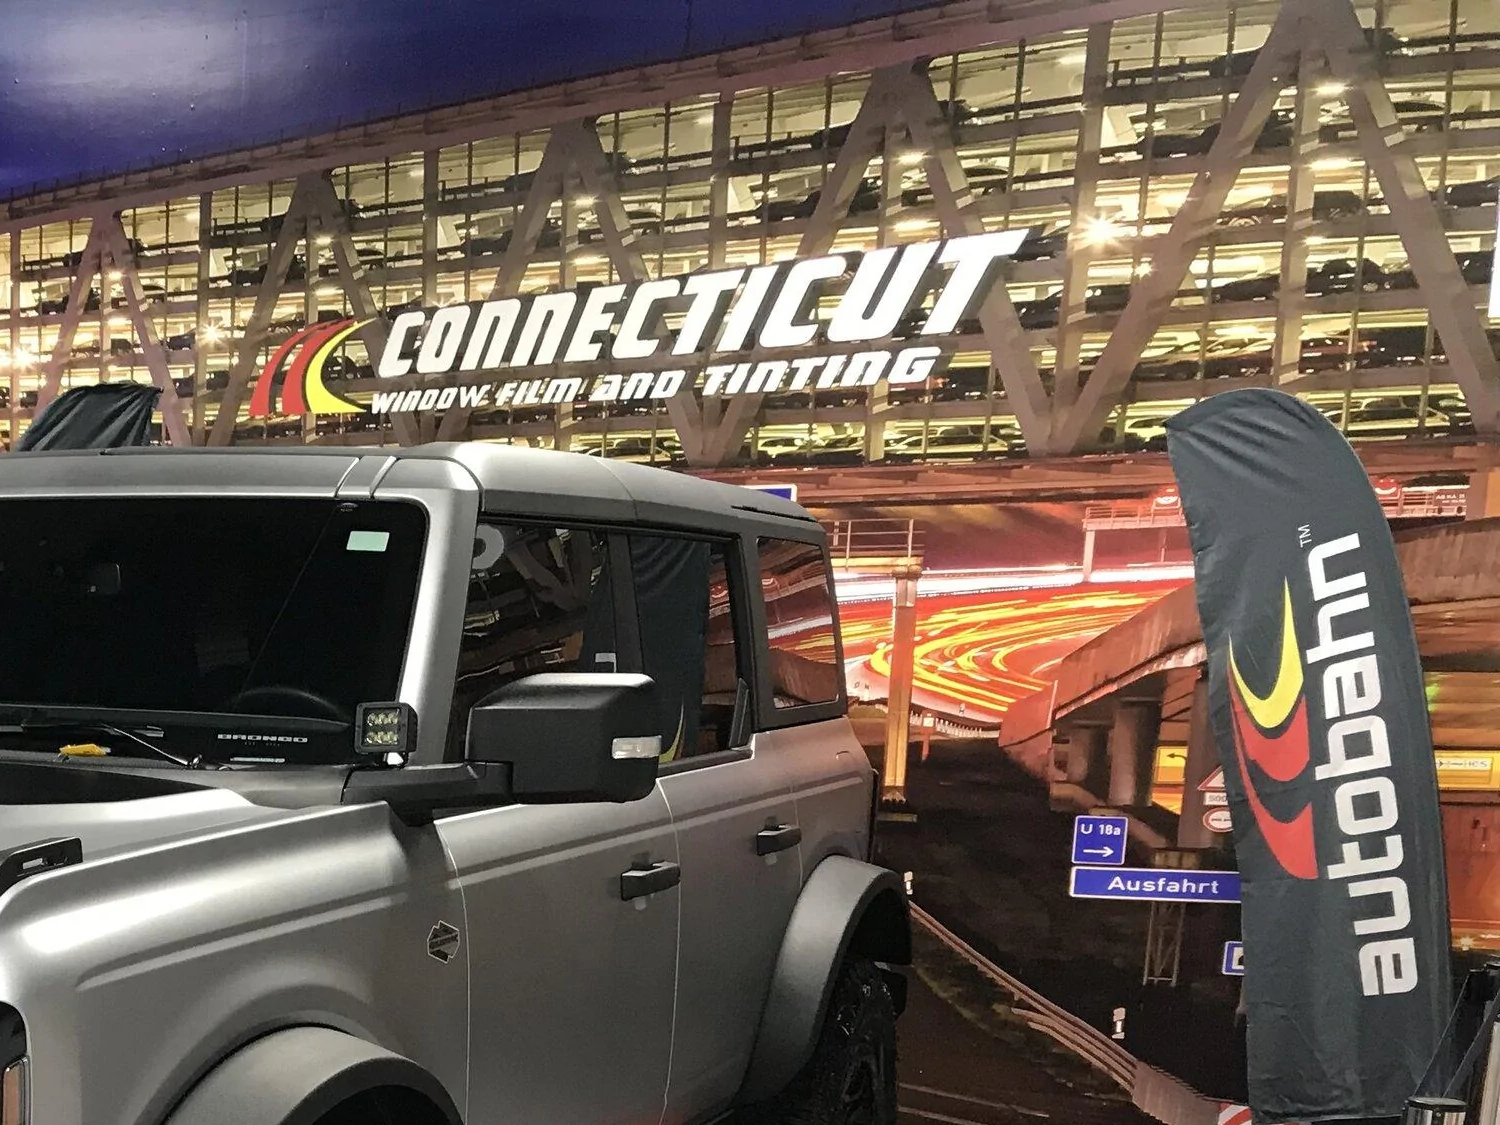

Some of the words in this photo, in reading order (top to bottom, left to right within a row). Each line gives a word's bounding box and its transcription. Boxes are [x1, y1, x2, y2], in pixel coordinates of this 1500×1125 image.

[377, 228, 1029, 378] CONNECTICUT
[371, 383, 490, 415] WINDOW
[495, 377, 583, 409] FILM
[702, 345, 940, 397] TINTING
[218, 734, 308, 743] BRONCO
[1307, 531, 1419, 997] autobahn
[1081, 824, 1093, 835] U
[1099, 824, 1121, 836] 18a
[1108, 876, 1219, 894] Ausfahrt
